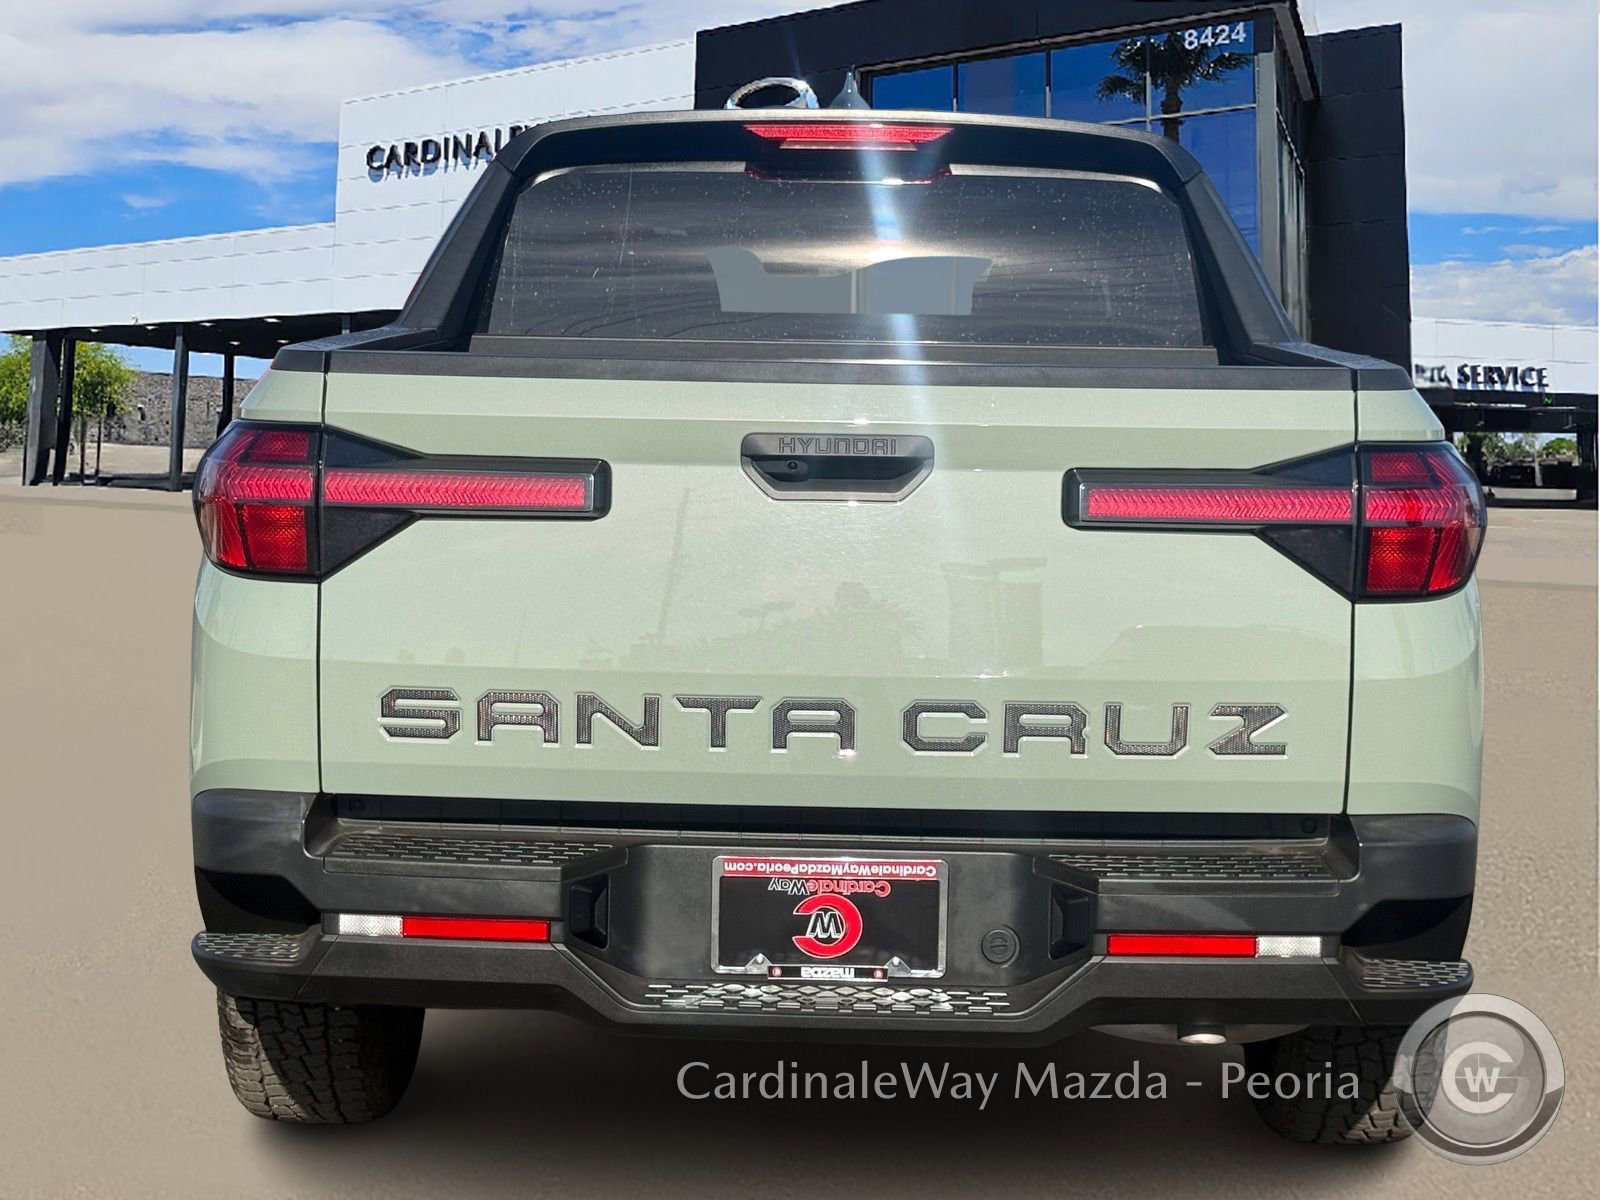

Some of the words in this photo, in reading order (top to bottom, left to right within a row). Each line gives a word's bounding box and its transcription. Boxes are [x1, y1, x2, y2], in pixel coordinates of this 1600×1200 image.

[1184, 21, 1246, 50] 8424
[1457, 363, 1549, 388] SERVICE
[778, 437, 897, 456] HYUNDAI
[378, 684, 859, 757] SANTA
[900, 699, 1290, 760] CRUZ
[723, 861, 938, 878] CardinaleWayMazdaPeoria.com
[800, 966, 855, 978] mazda
